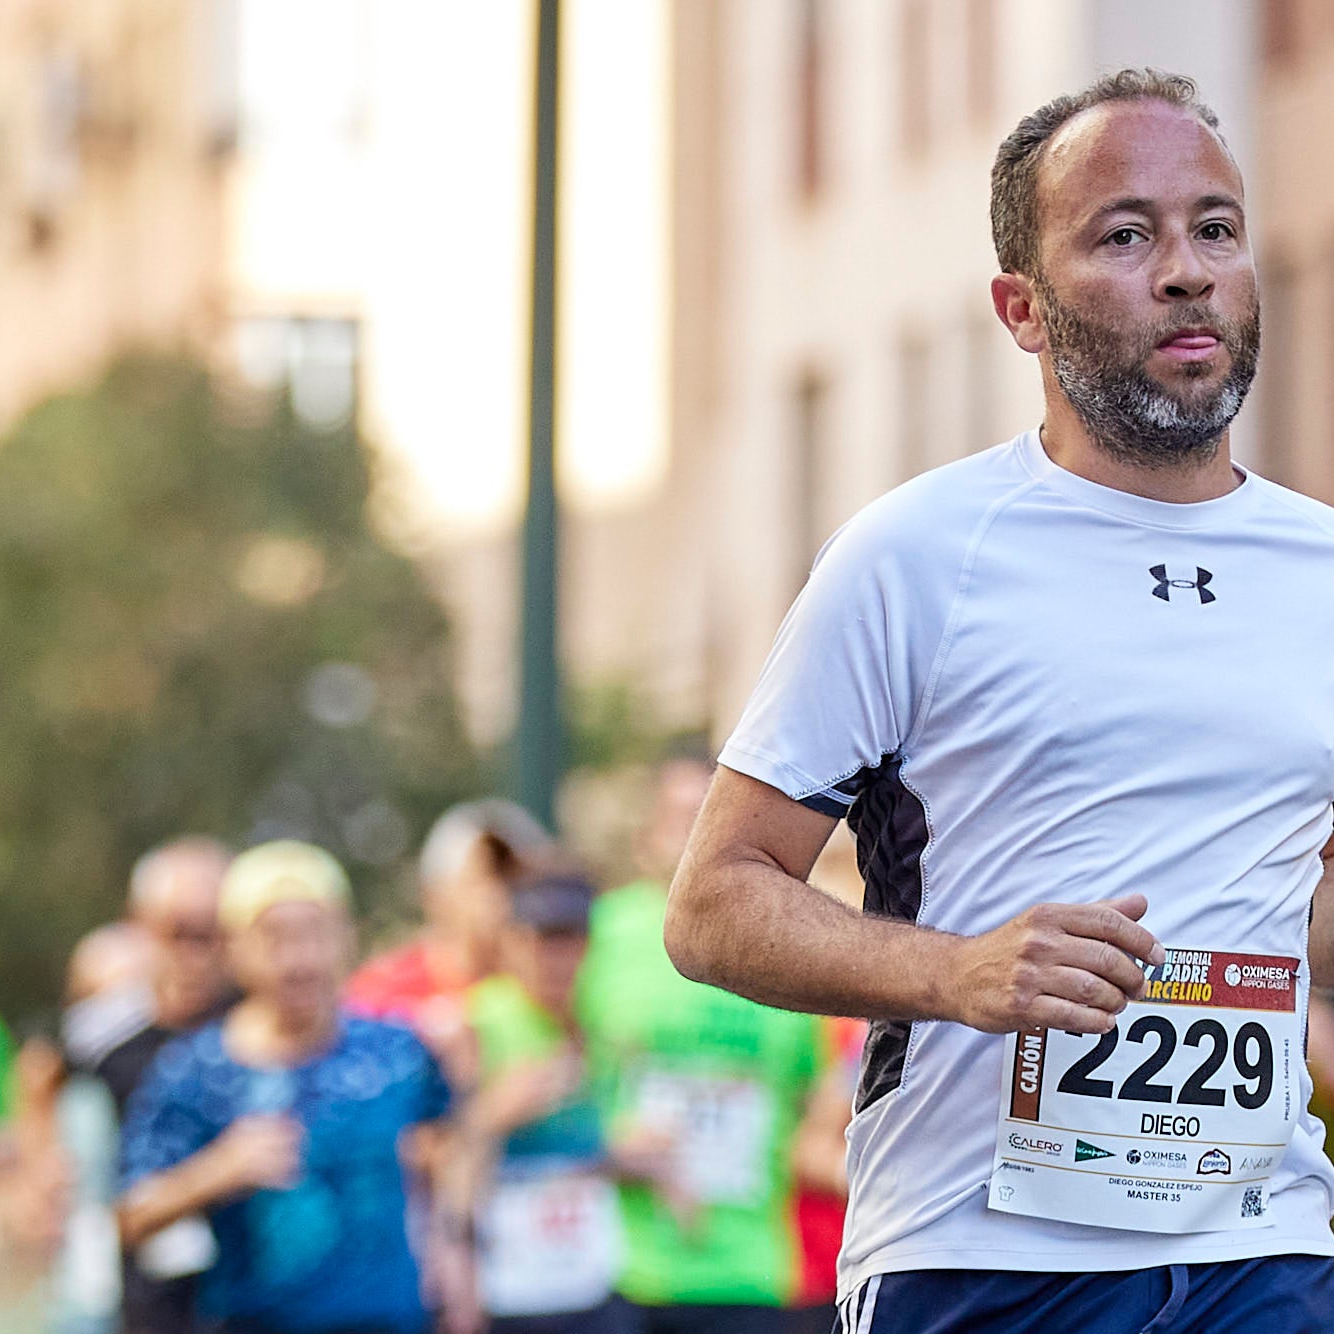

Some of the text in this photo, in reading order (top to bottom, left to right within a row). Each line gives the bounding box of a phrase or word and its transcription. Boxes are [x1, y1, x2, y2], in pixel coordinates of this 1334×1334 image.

[1166, 951, 1212, 966] MEMORIAL
[1161, 964, 1208, 984] PADRE
[1241, 965, 1290, 980] OXIMESA
[1145, 980, 1212, 1002] ARCELINO
[1241, 979, 1290, 991] NIPPON GASES
[1019, 1034, 1043, 1094] CAJÓN
[1057, 1015, 1273, 1110] 2229
[1140, 1113, 1201, 1137] DIEGO
[1012, 1136, 1062, 1152] CALERO
[1142, 1150, 1188, 1162] OXIMESA
[1109, 1177, 1203, 1191] DIEGO GONZALEZ ESPEJO
[1127, 1190, 1181, 1202] MASTER 35
